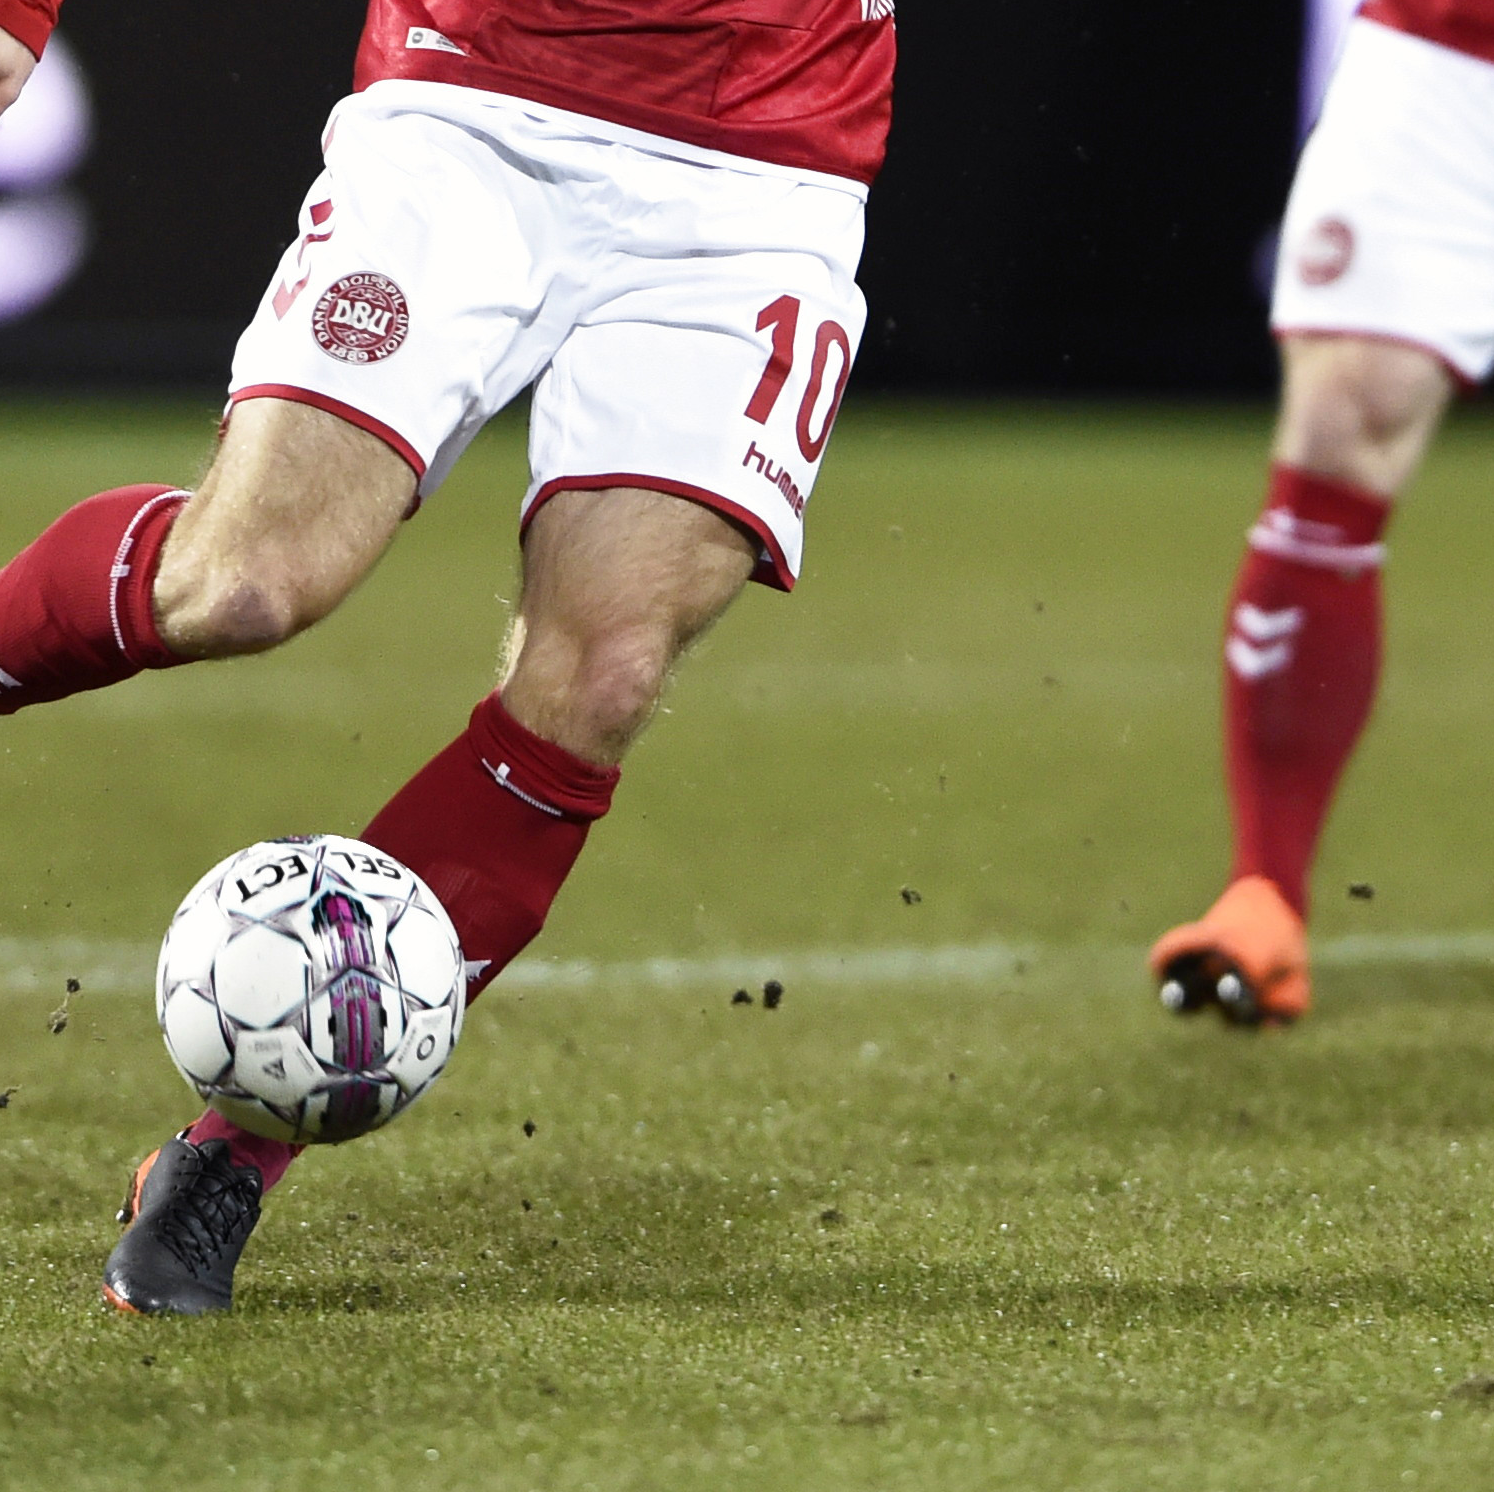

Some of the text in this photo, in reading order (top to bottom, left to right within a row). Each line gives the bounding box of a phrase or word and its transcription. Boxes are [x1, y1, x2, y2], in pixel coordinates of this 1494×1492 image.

[329, 299, 393, 337] DBU
[744, 294, 851, 463] 10
[742, 441, 805, 521] humme
